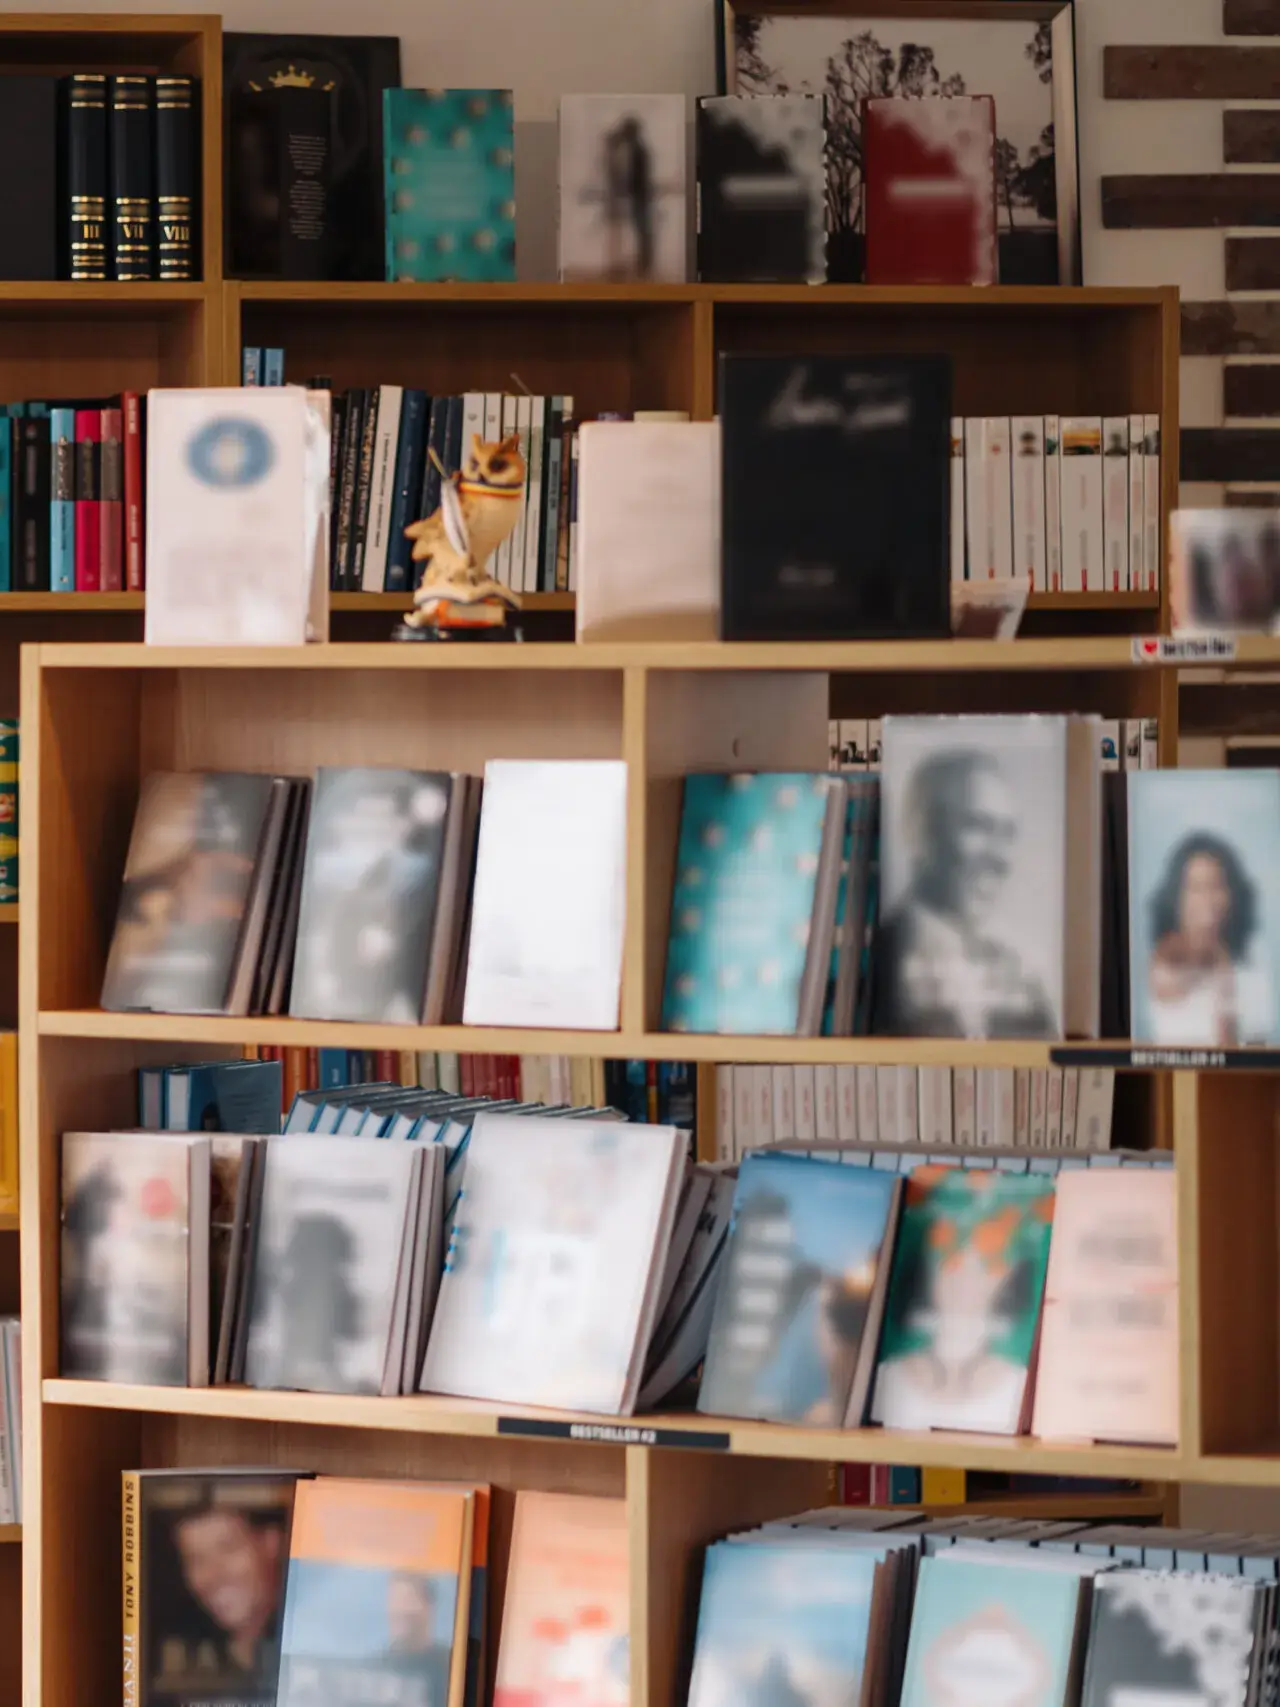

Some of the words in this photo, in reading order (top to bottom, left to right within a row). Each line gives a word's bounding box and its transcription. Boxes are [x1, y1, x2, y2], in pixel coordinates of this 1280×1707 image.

[122, 224, 144, 239] VII
[163, 225, 190, 240] VIII
[1131, 1051, 1208, 1067] BESTSELLER
[570, 1424, 640, 1442] BESTSELLER
[125, 1480, 135, 1563] ROBBINS
[125, 1572, 135, 1619] TONY
